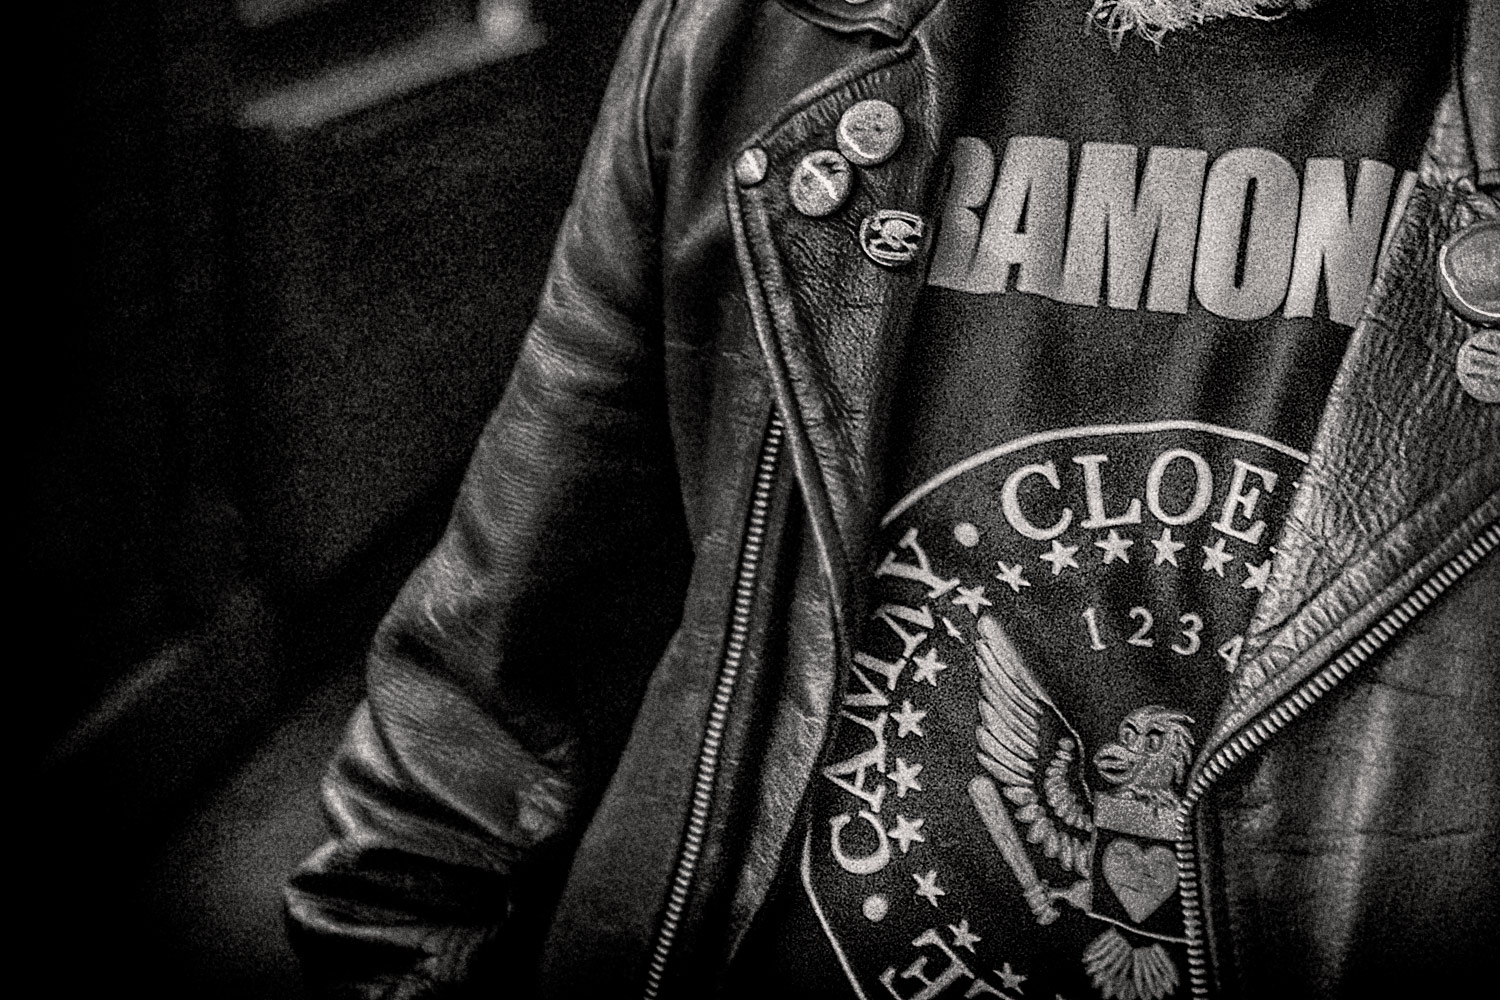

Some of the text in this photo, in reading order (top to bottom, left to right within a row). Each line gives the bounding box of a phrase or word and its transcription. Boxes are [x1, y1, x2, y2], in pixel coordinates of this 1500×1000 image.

[927, 135, 1418, 327] RAMON
[1001, 448, 1299, 545] CLOE
[1081, 605, 1246, 674] 1 2 3 4
